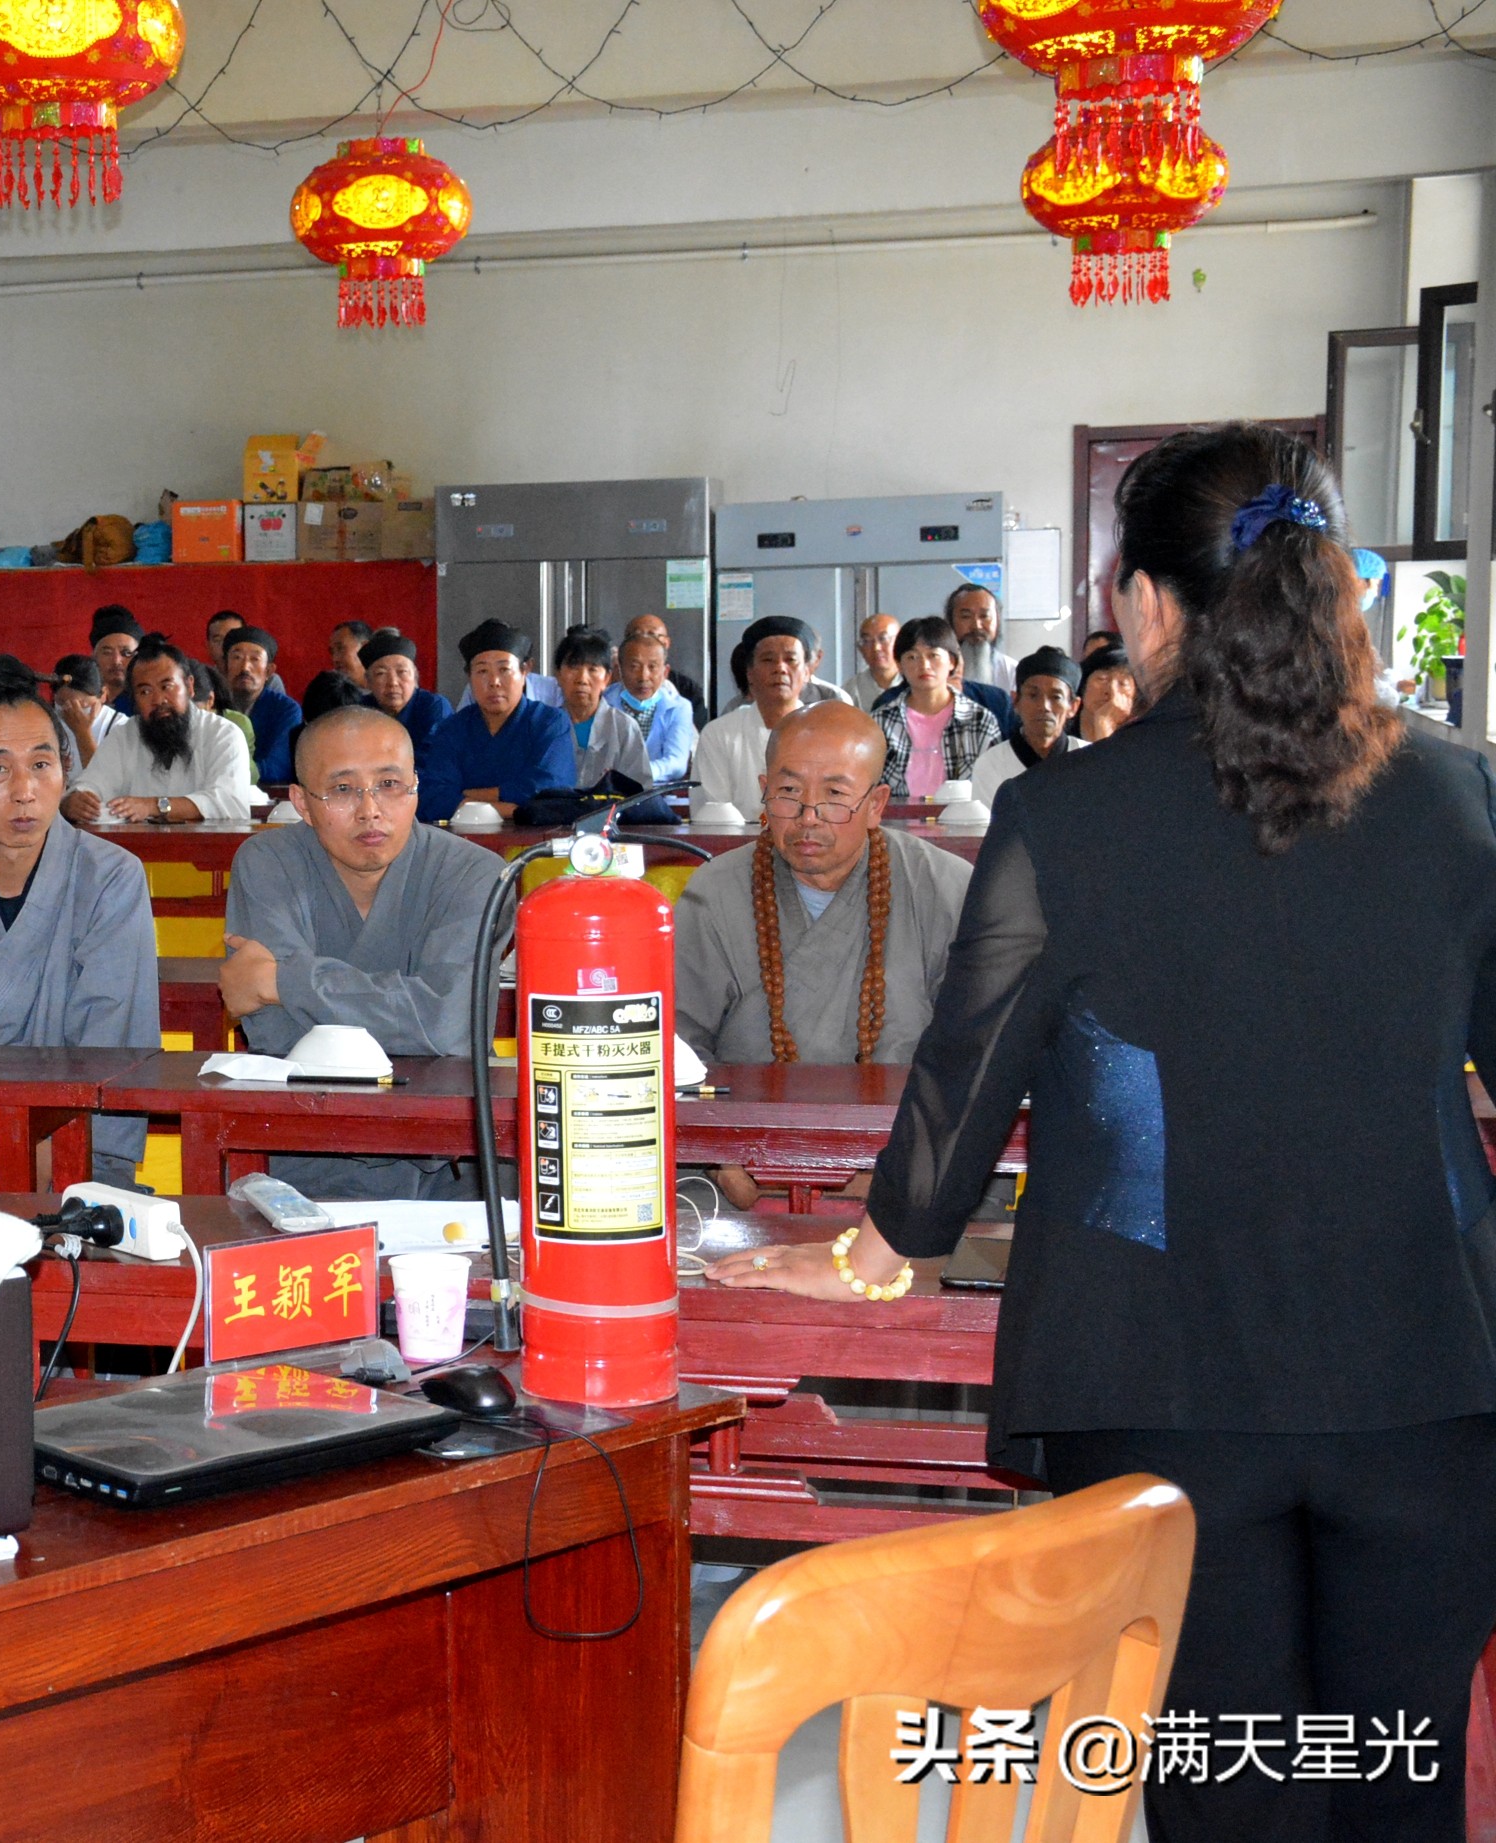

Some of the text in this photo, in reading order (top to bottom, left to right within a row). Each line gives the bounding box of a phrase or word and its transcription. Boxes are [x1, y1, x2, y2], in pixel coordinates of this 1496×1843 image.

[572, 1025, 621, 1034] MFZ/ABC 5A
[540, 1041, 651, 1058] 手提式干粉灭火器
[223, 1252, 363, 1325] 王颖军
